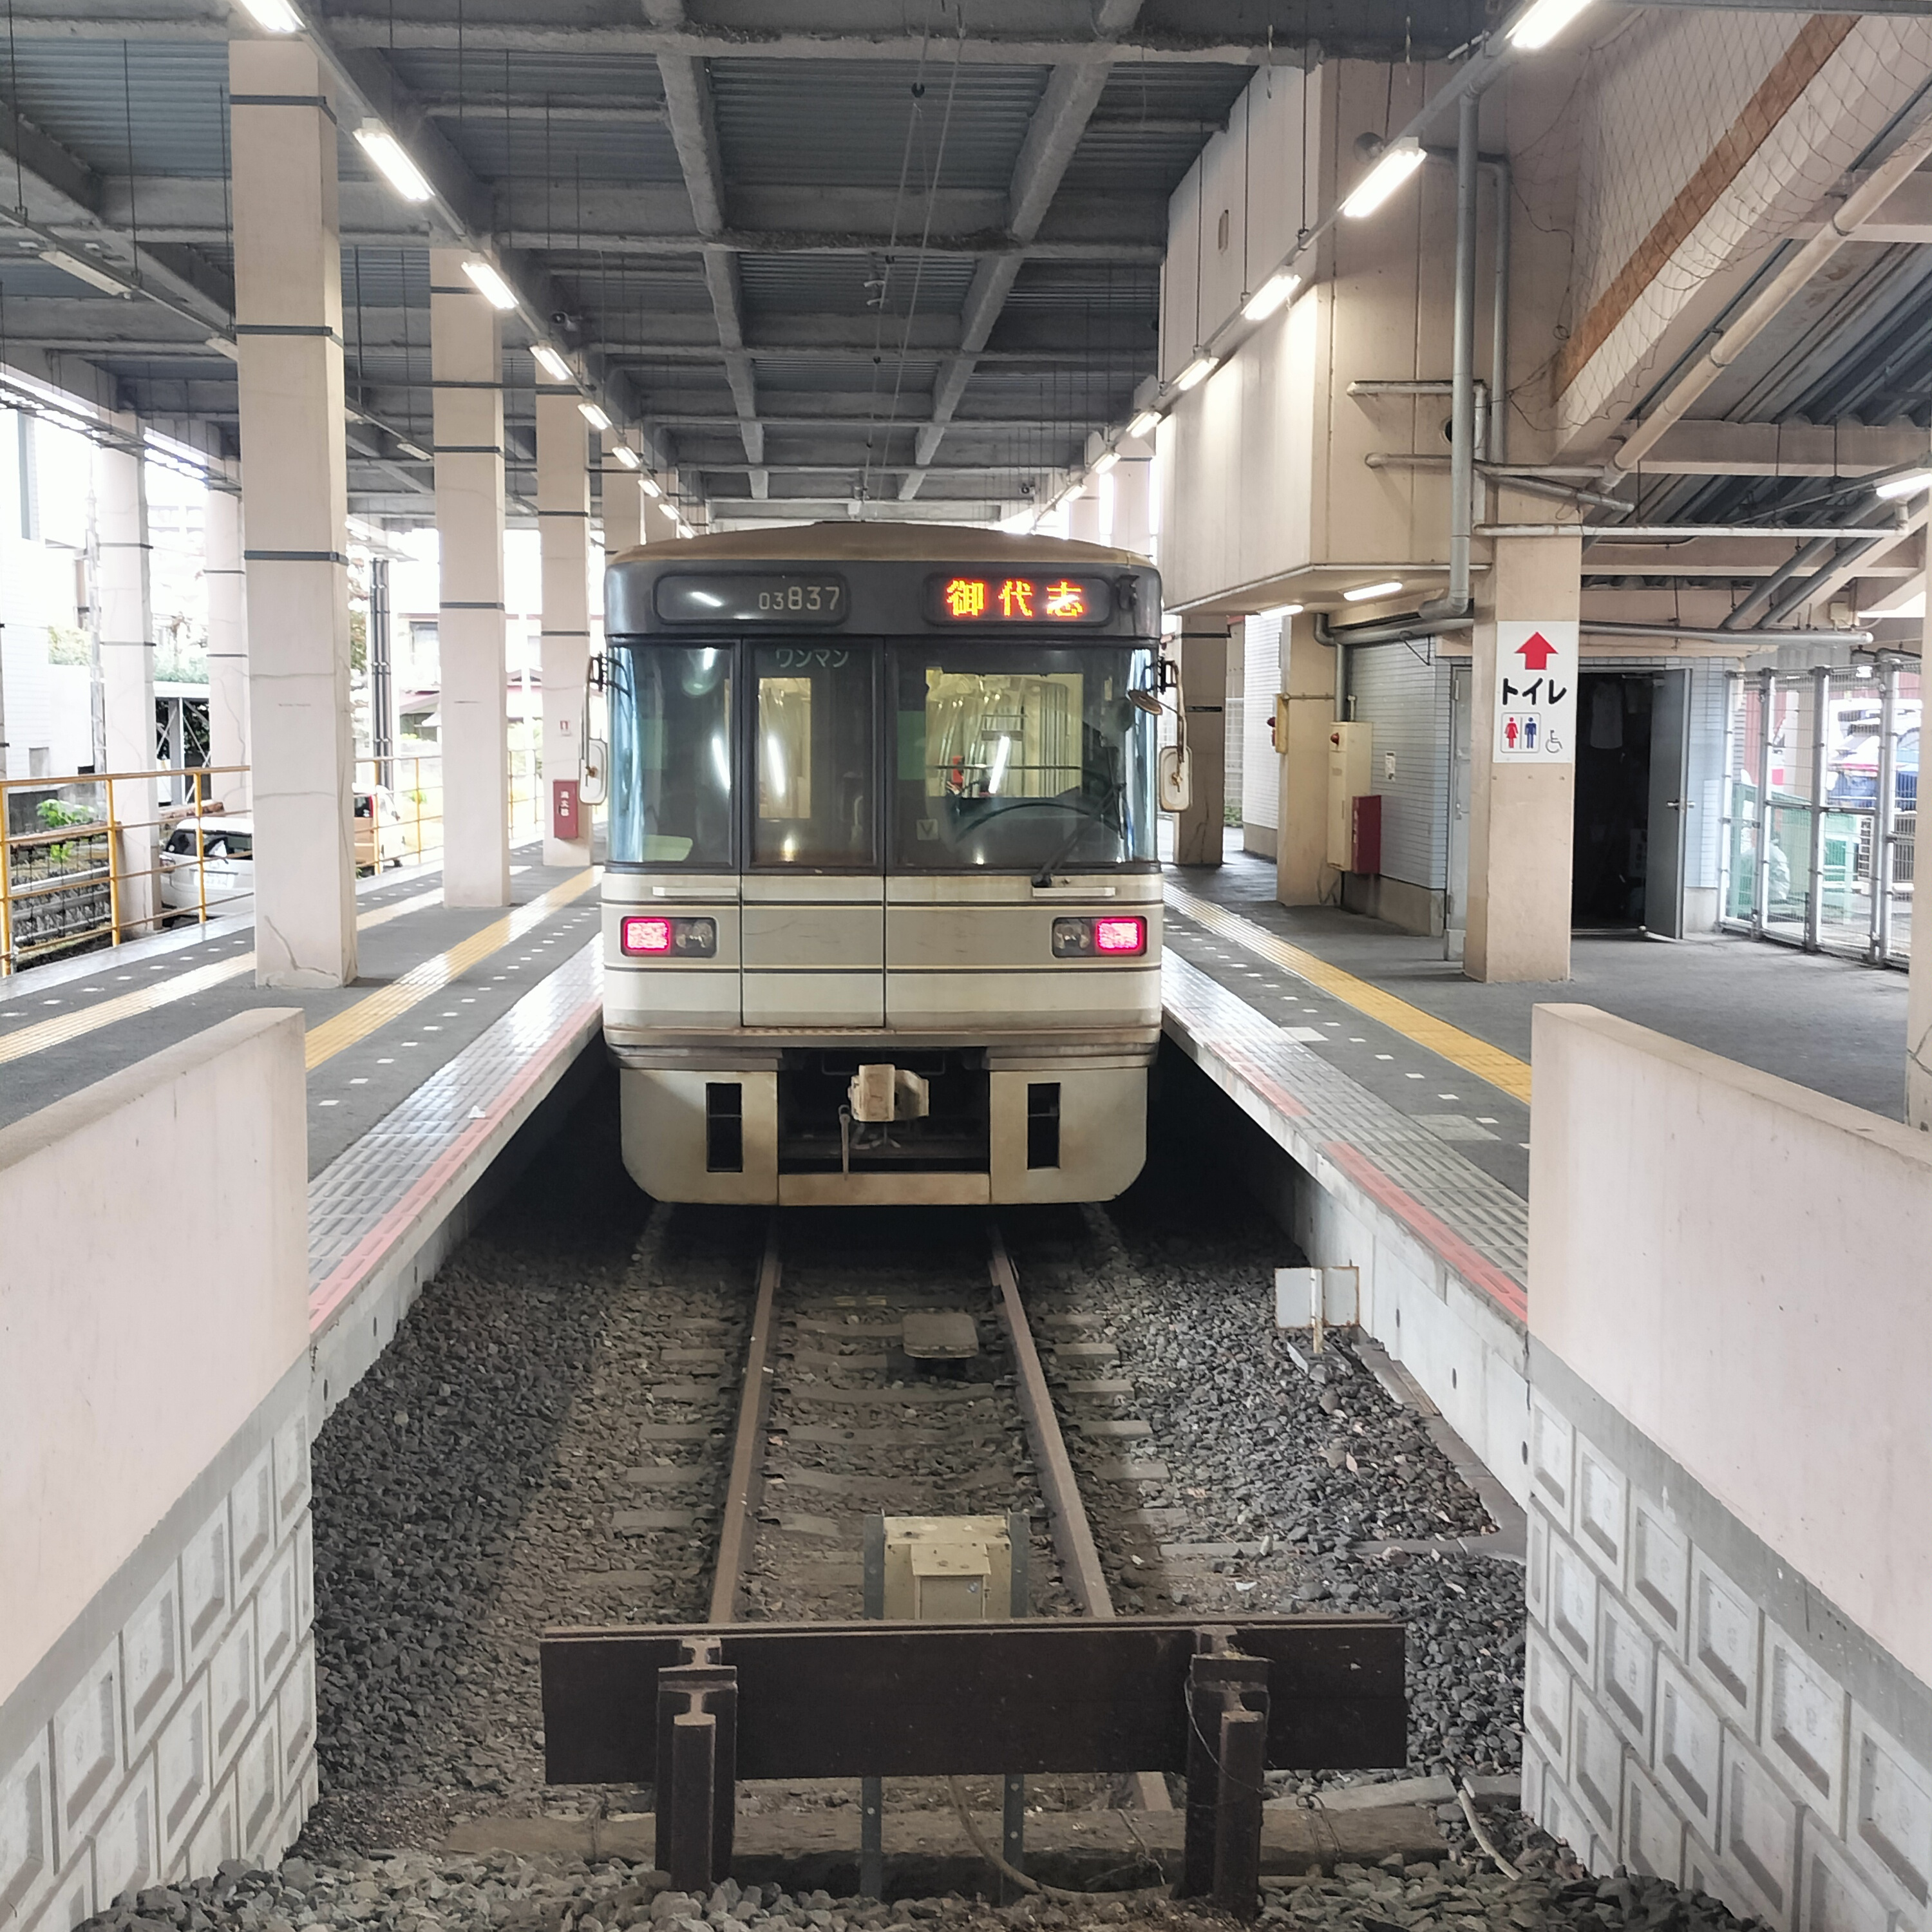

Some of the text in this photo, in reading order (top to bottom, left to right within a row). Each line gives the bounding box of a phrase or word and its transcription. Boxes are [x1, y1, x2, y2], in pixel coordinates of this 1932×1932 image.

[759, 585, 840, 611] 03837
[945, 579, 1084, 617] 御代志
[775, 649, 849, 668] ワンマン
[1502, 677, 1567, 705] トイレ
